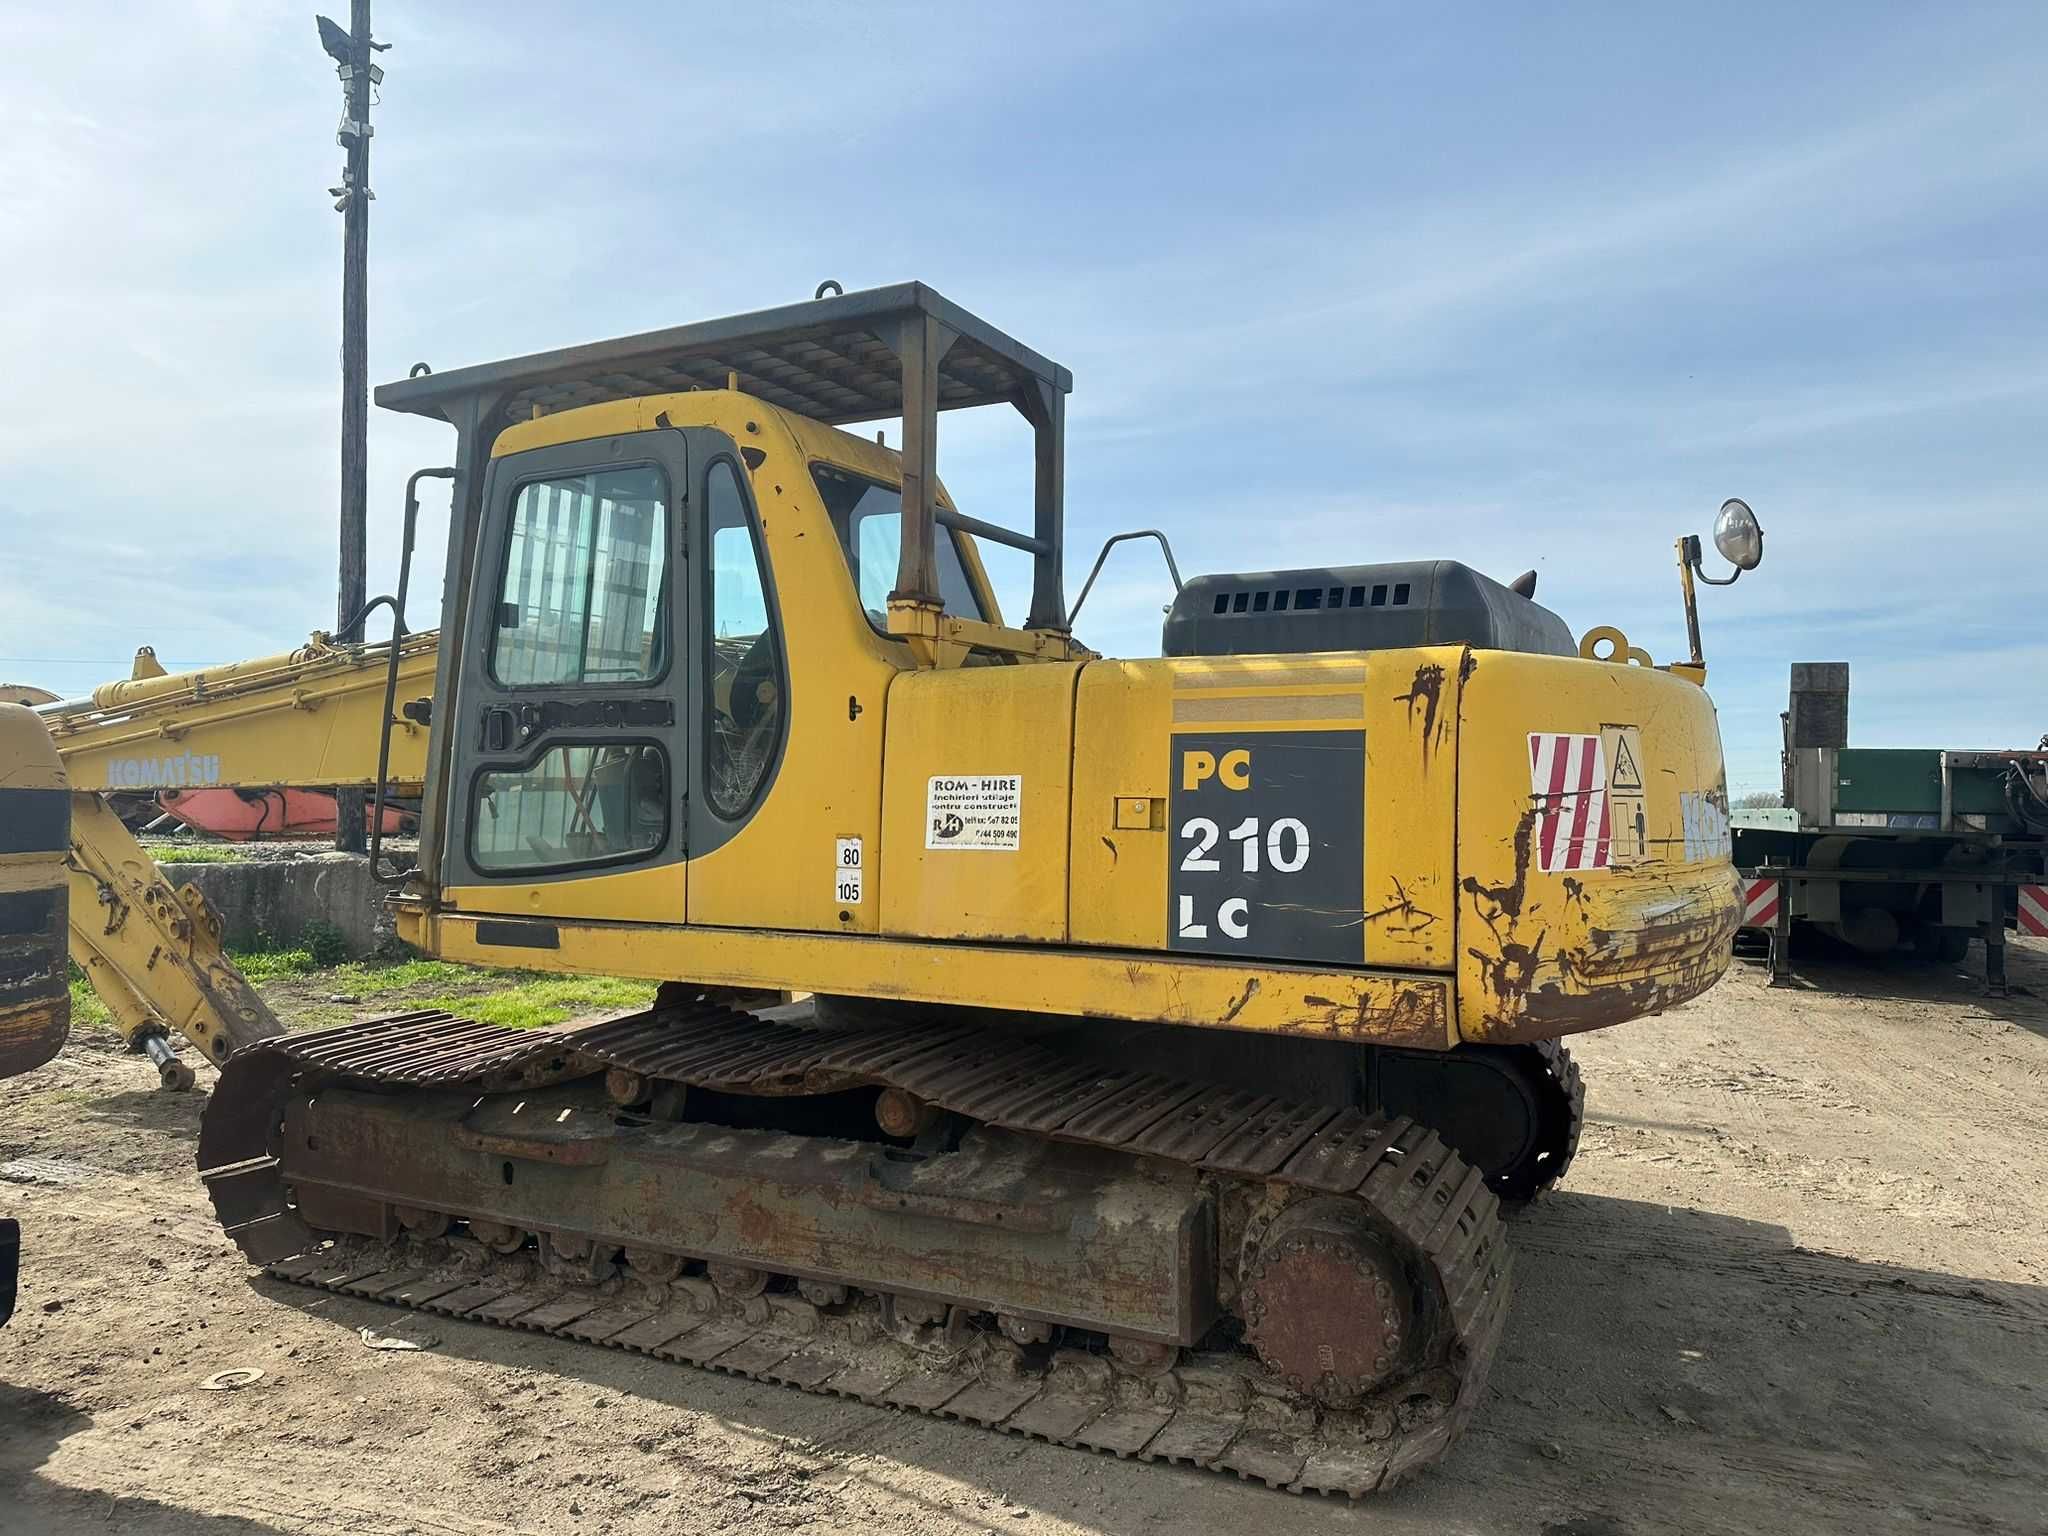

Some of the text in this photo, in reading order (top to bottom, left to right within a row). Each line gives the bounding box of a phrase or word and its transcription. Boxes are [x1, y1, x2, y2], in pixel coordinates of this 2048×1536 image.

[107, 754, 219, 785] KOMATSU
[1182, 749, 1250, 791] PC
[935, 780, 968, 791] ROM
[981, 780, 1016, 791] HIRE
[1000, 816, 1009, 824] 82
[992, 829, 1005, 838] 509
[1180, 817, 1310, 873] 210
[843, 848, 859, 865] 80
[838, 883, 859, 901] 105
